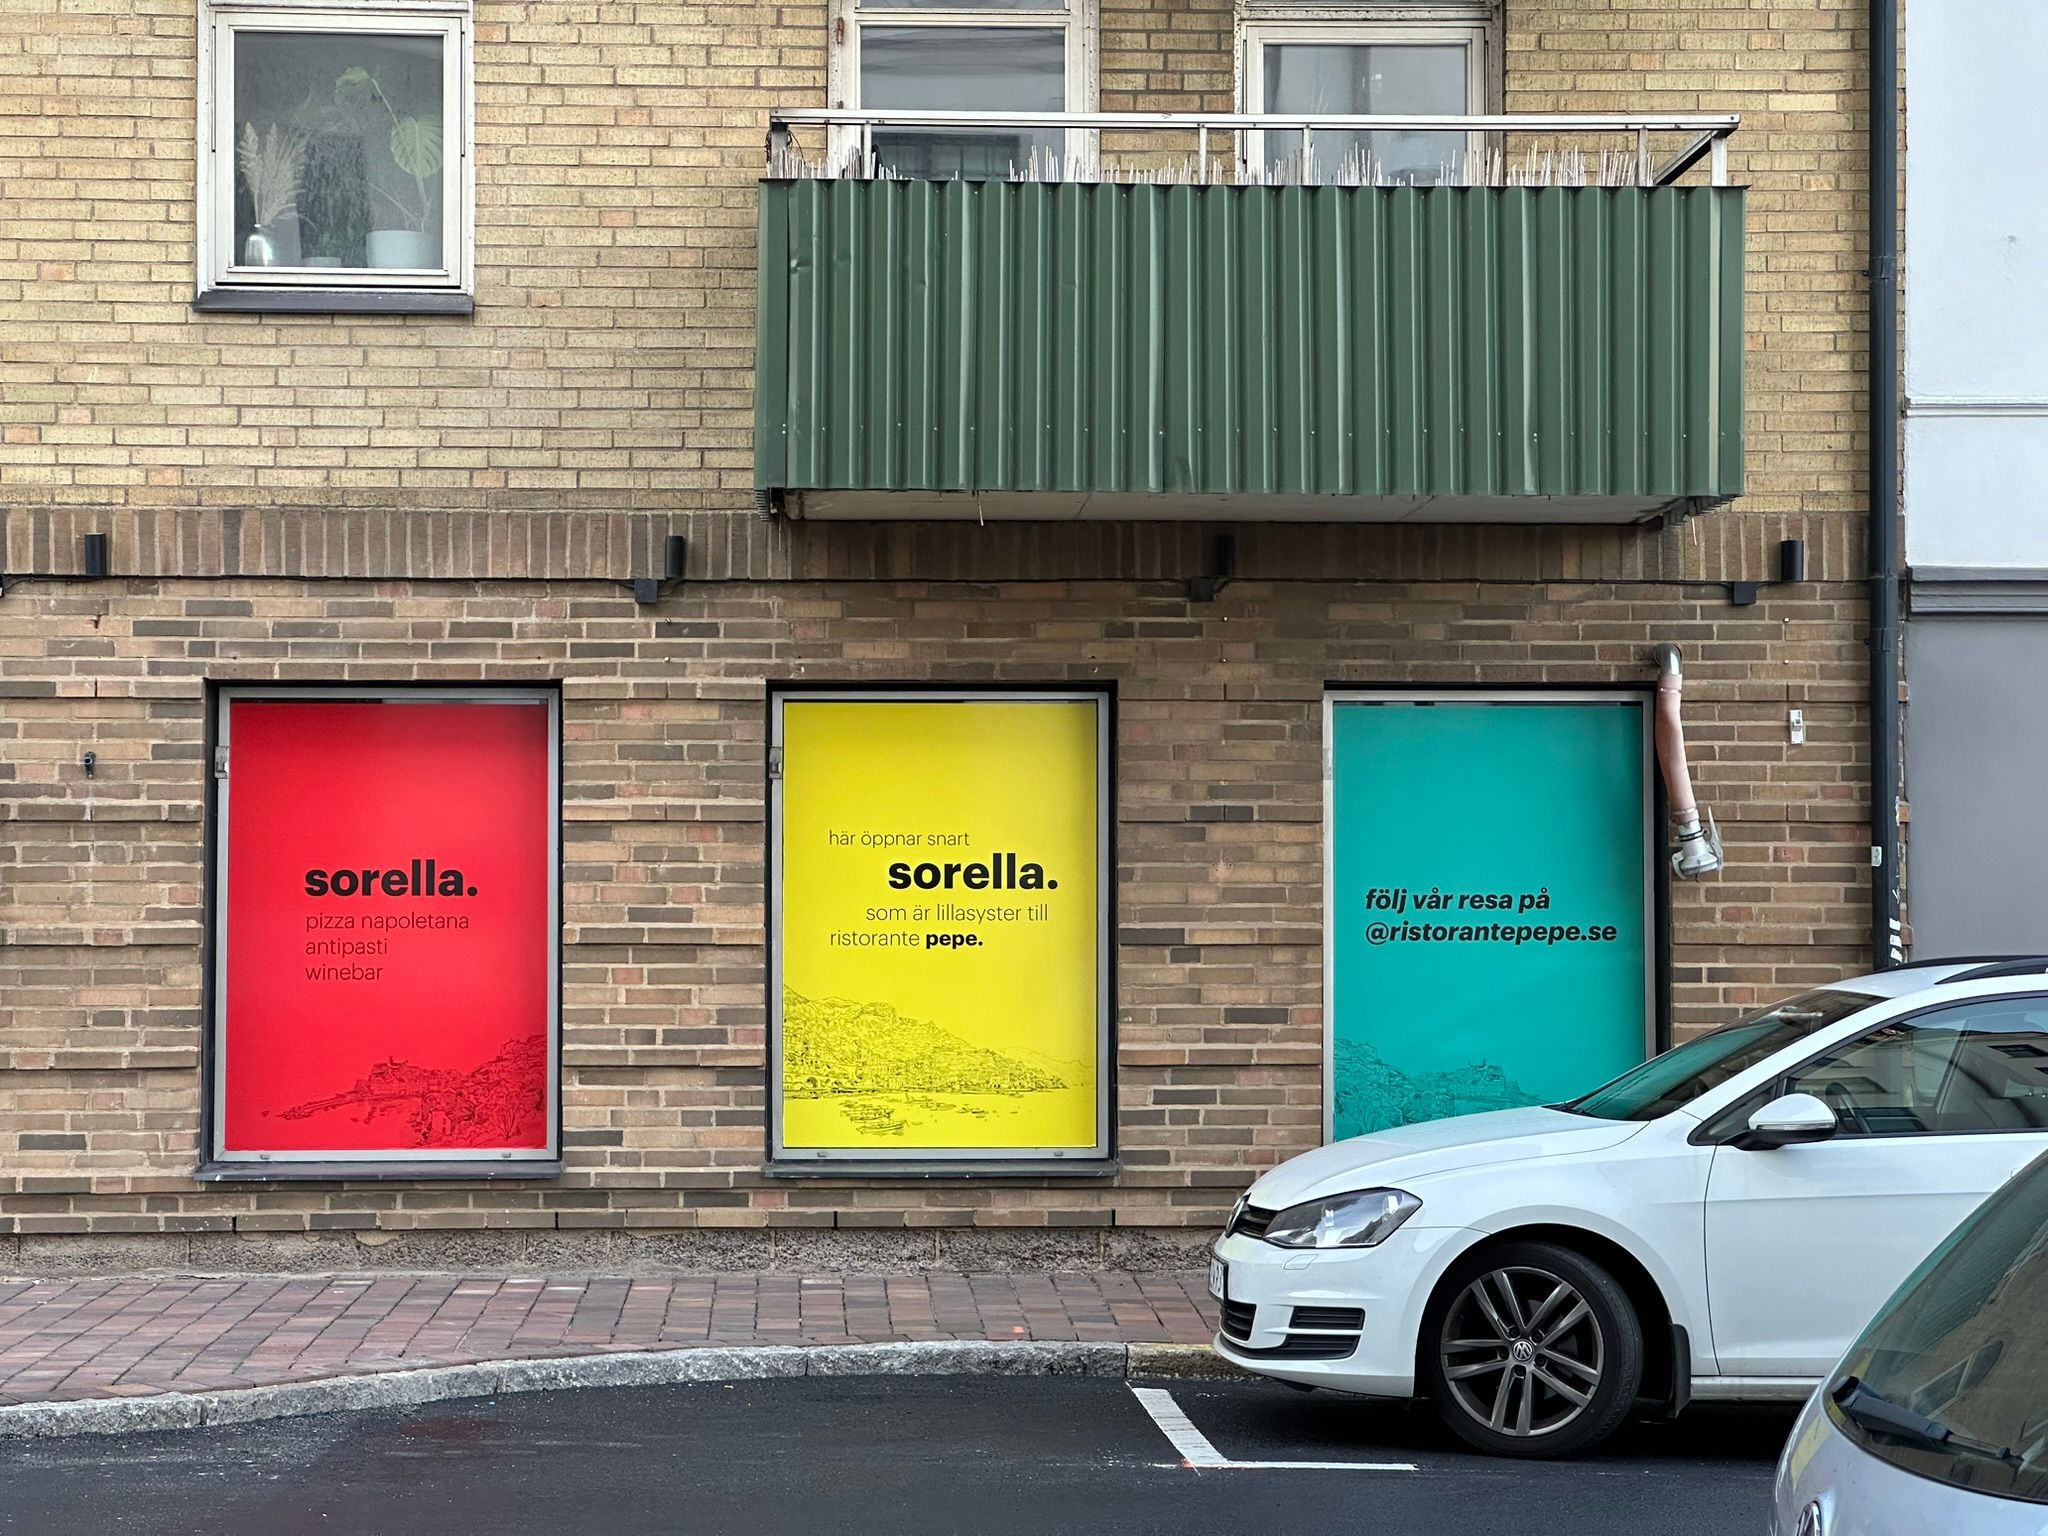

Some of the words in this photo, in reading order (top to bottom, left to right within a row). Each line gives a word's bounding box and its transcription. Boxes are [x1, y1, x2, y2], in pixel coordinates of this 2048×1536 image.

[829, 829, 856, 846] här
[860, 830, 922, 849] öppnar
[927, 832, 970, 847] snart
[305, 858, 478, 897] sorella.
[888, 852, 1059, 890] sorella.
[1365, 887, 1407, 914] följ
[1412, 886, 1454, 910] vår
[1457, 893, 1513, 911] resa
[1517, 886, 1551, 914] på
[306, 912, 355, 932] pizza
[361, 912, 469, 931] napoletana
[866, 907, 907, 921] som
[912, 904, 931, 922] är
[936, 904, 1022, 925] lillasyster
[1027, 903, 1048, 922] till
[830, 929, 920, 947] ristorante
[925, 933, 984, 950] pepe.
[1365, 920, 1617, 946] @ristorantepepe.se
[305, 938, 388, 957] antipasti
[305, 962, 384, 981] winebar
